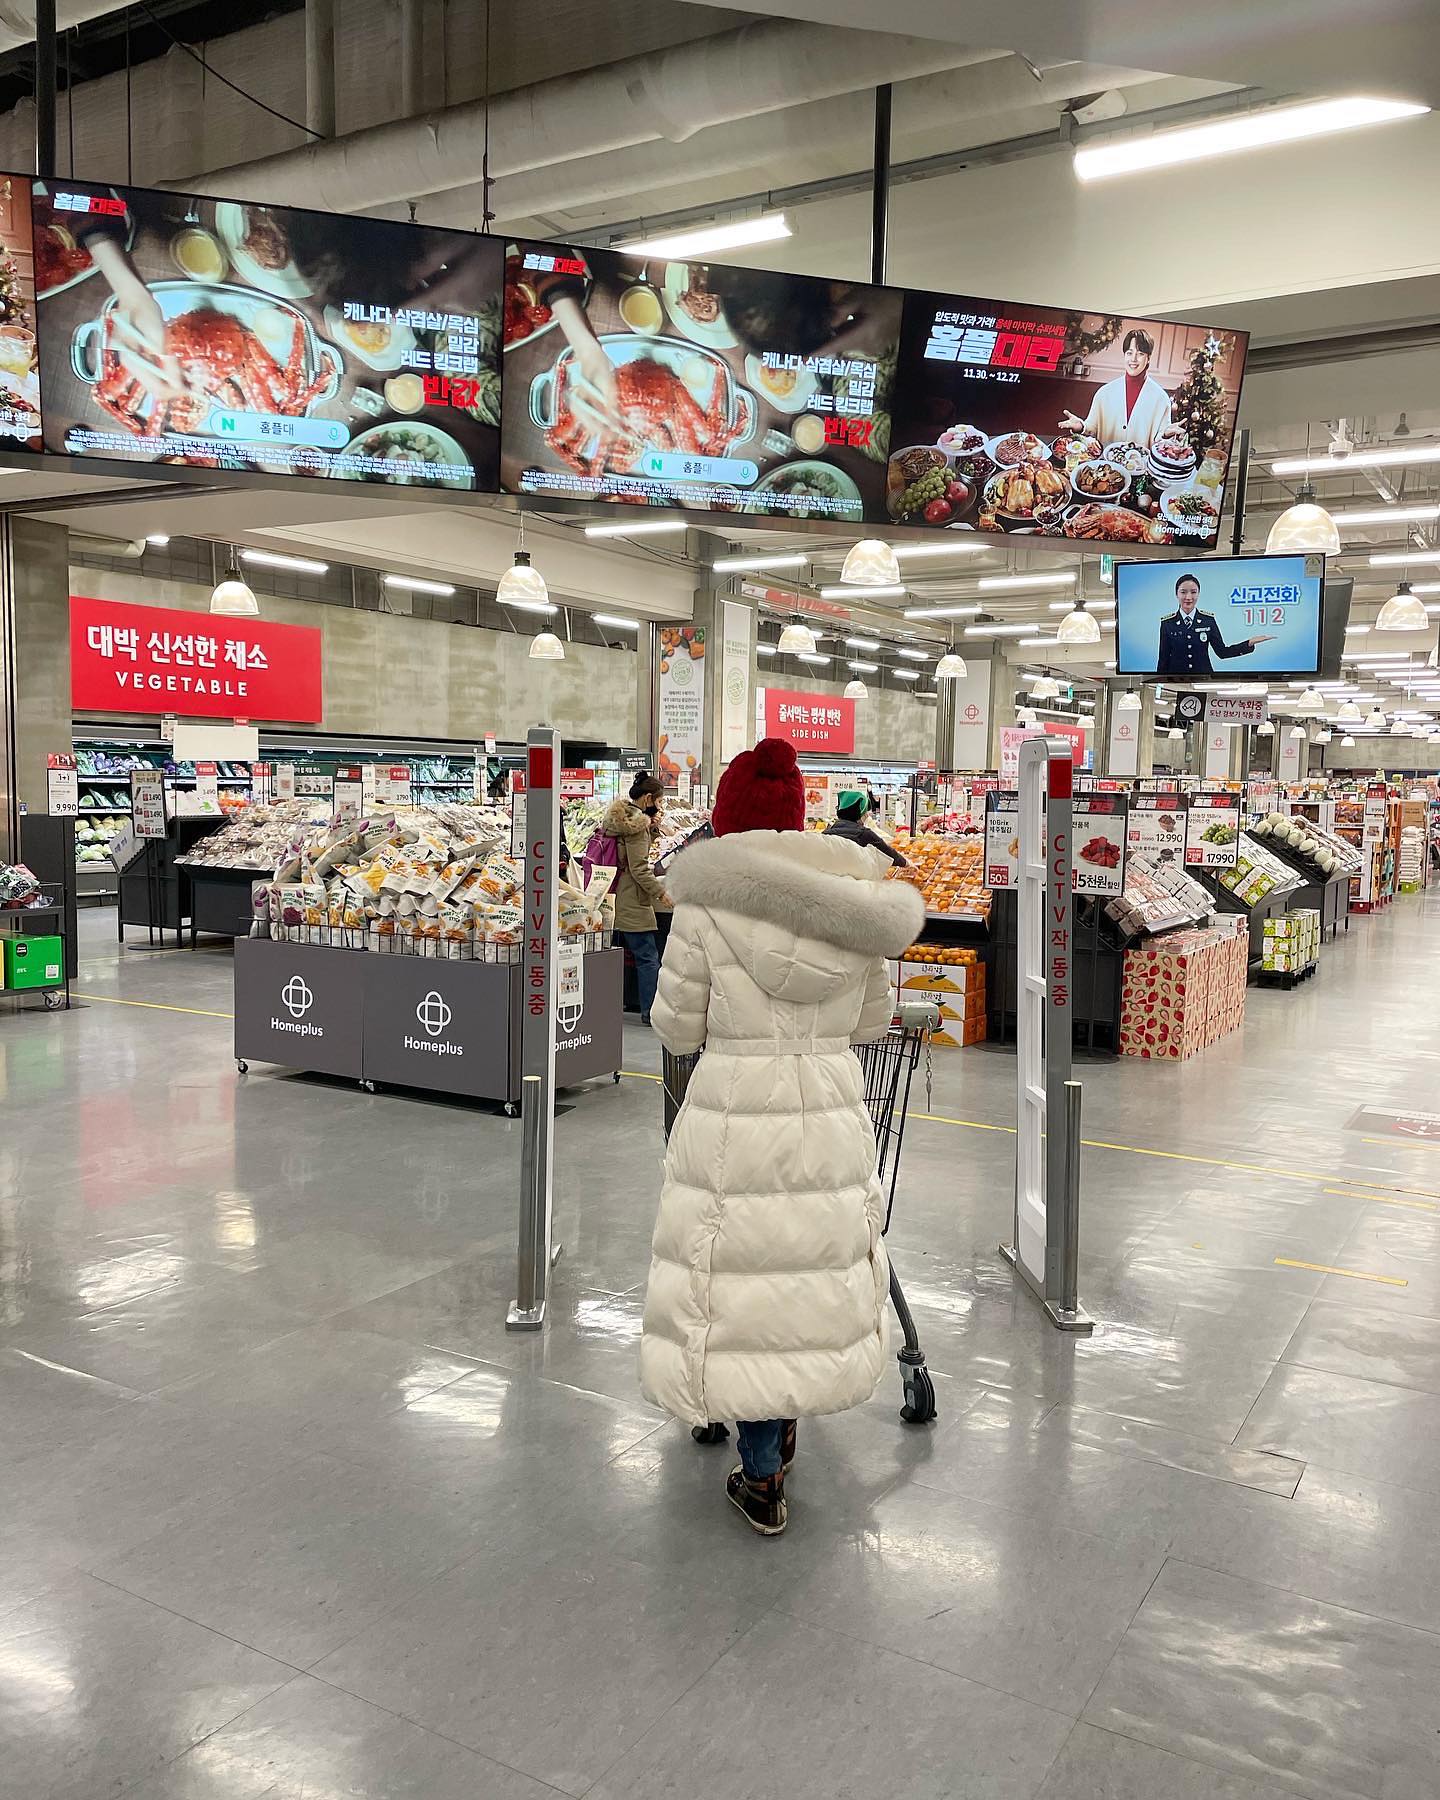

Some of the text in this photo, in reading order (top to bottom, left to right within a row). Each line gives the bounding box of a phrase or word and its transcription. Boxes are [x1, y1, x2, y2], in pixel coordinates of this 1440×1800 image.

[343, 302, 393, 325] 캐나다
[934, 311, 960, 325] 압도적
[959, 313, 977, 326] 맛과
[976, 316, 997, 328] 가격!
[447, 335, 480, 355] 밀감
[924, 324, 1065, 372] 홈플대란
[400, 349, 479, 374] 레드 킹크랩
[761, 351, 804, 371] 캐나다
[963, 368, 988, 380] 11.30.
[996, 372, 1021, 384] 12.27.
[422, 374, 482, 410] 반값
[806, 393, 834, 412] 레드
[259, 420, 294, 437] 홈플대
[824, 415, 875, 449] 반값
[1154, 524, 1198, 537] Homeplus
[1229, 585, 1300, 605] 신고전화
[1244, 607, 1283, 624] 112
[87, 625, 269, 671] 대박 신선한 채소
[115, 671, 248, 697] VEGETABLE
[1210, 699, 1263, 711] CCTV 녹화중
[779, 703, 842, 727] 줄서먹는 평생 반찬
[791, 728, 829, 740] SIDE DISH
[54, 754, 71, 766] 1+1
[58, 773, 70, 781] 1+1
[56, 803, 77, 813] 9,990
[1077, 873, 1108, 889] 5천원
[270, 1017, 324, 1037] Homeplus
[403, 1035, 464, 1057] Homeplus
[555, 1033, 592, 1052] omeplus
